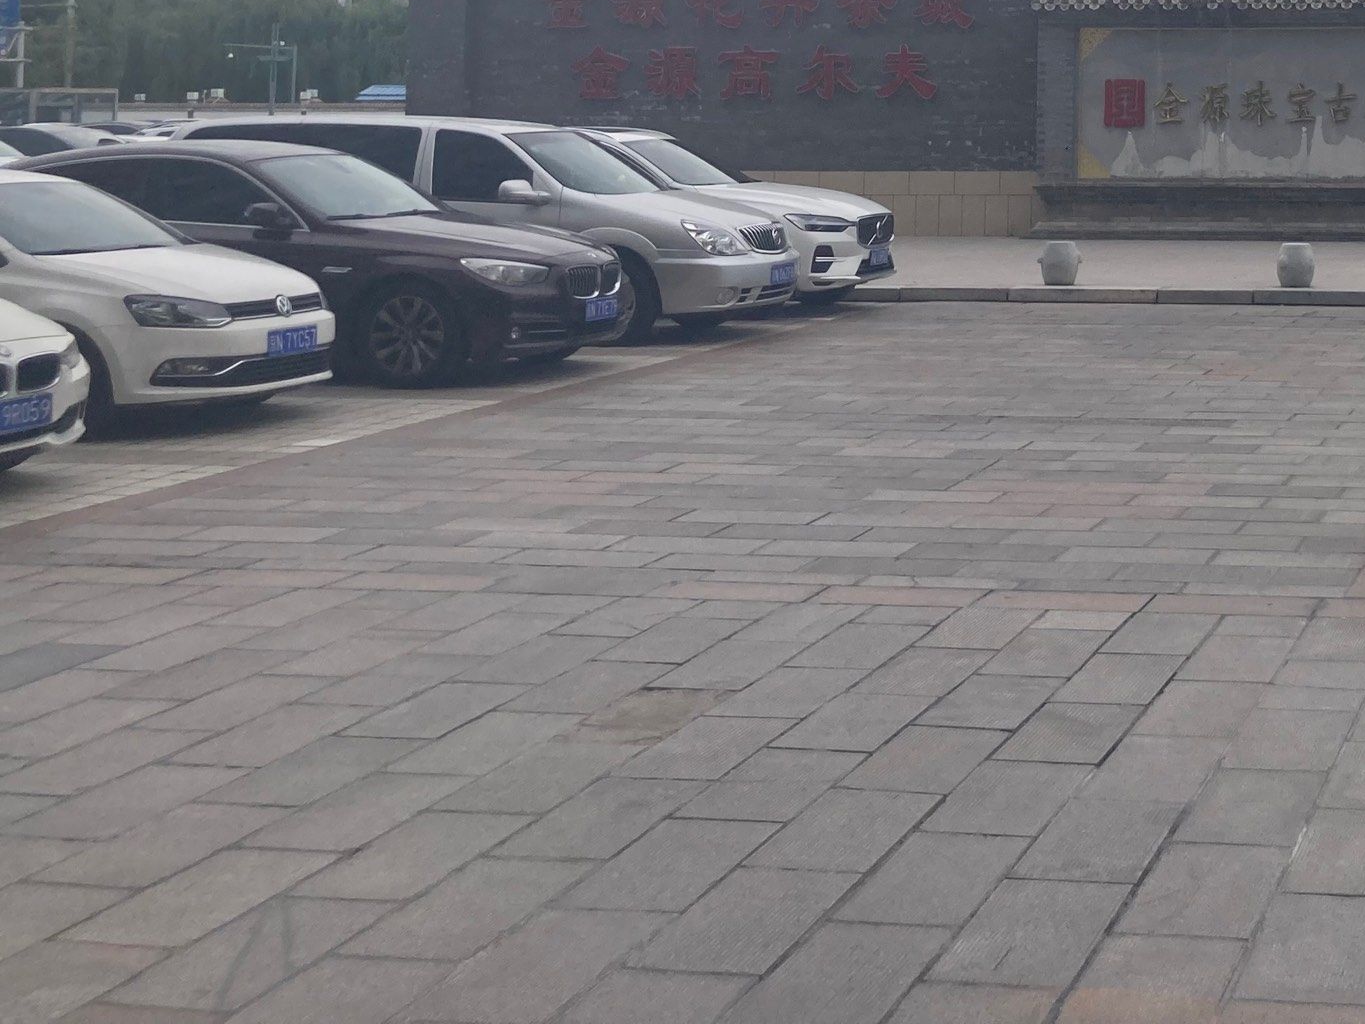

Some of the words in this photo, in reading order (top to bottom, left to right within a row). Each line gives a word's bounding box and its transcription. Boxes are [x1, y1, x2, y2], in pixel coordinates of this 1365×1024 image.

[572, 44, 938, 101] 金源高尔夫
